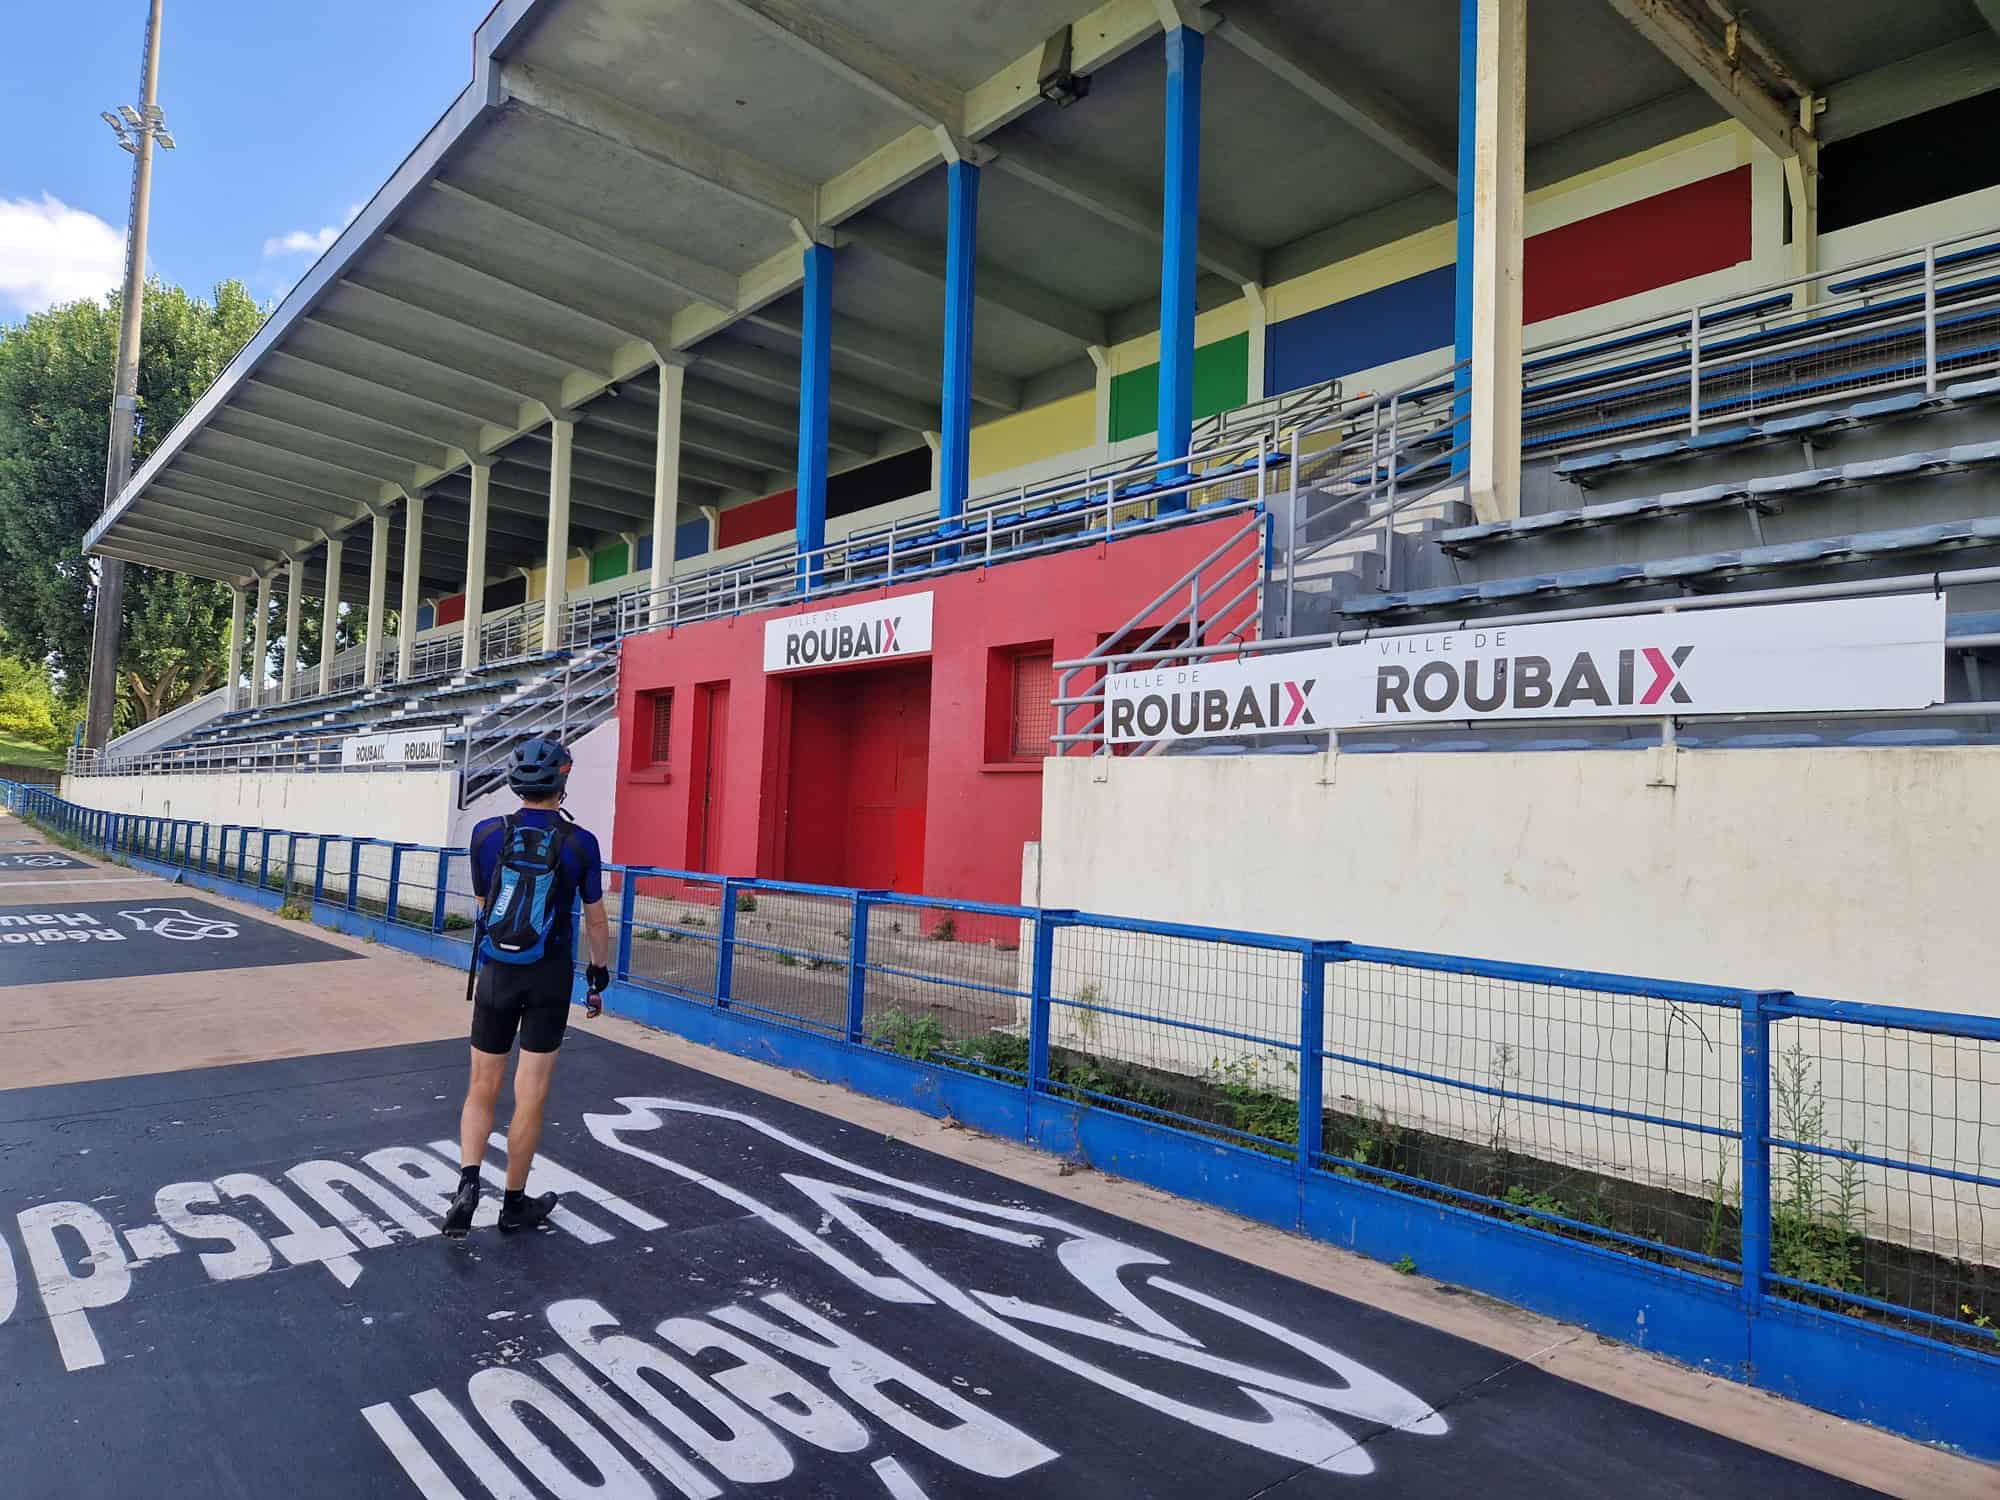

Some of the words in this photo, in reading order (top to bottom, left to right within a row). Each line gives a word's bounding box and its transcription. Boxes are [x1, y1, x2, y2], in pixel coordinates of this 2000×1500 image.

[786, 616, 902, 666] ROUBAIX
[1380, 636, 1453, 656] VILLE
[1475, 631, 1507, 648] DE
[1113, 671, 1164, 690] VILLE
[1178, 669, 1200, 685] DE
[1375, 645, 1695, 714] ROUBAIX
[1111, 679, 1317, 738] ROUBAIX
[355, 744, 385, 762] ROUBAIX
[404, 740, 440, 761] ROUBAIX
[0, 927, 128, 945] Régio
[0, 1132, 668, 1372] Hauts-d
